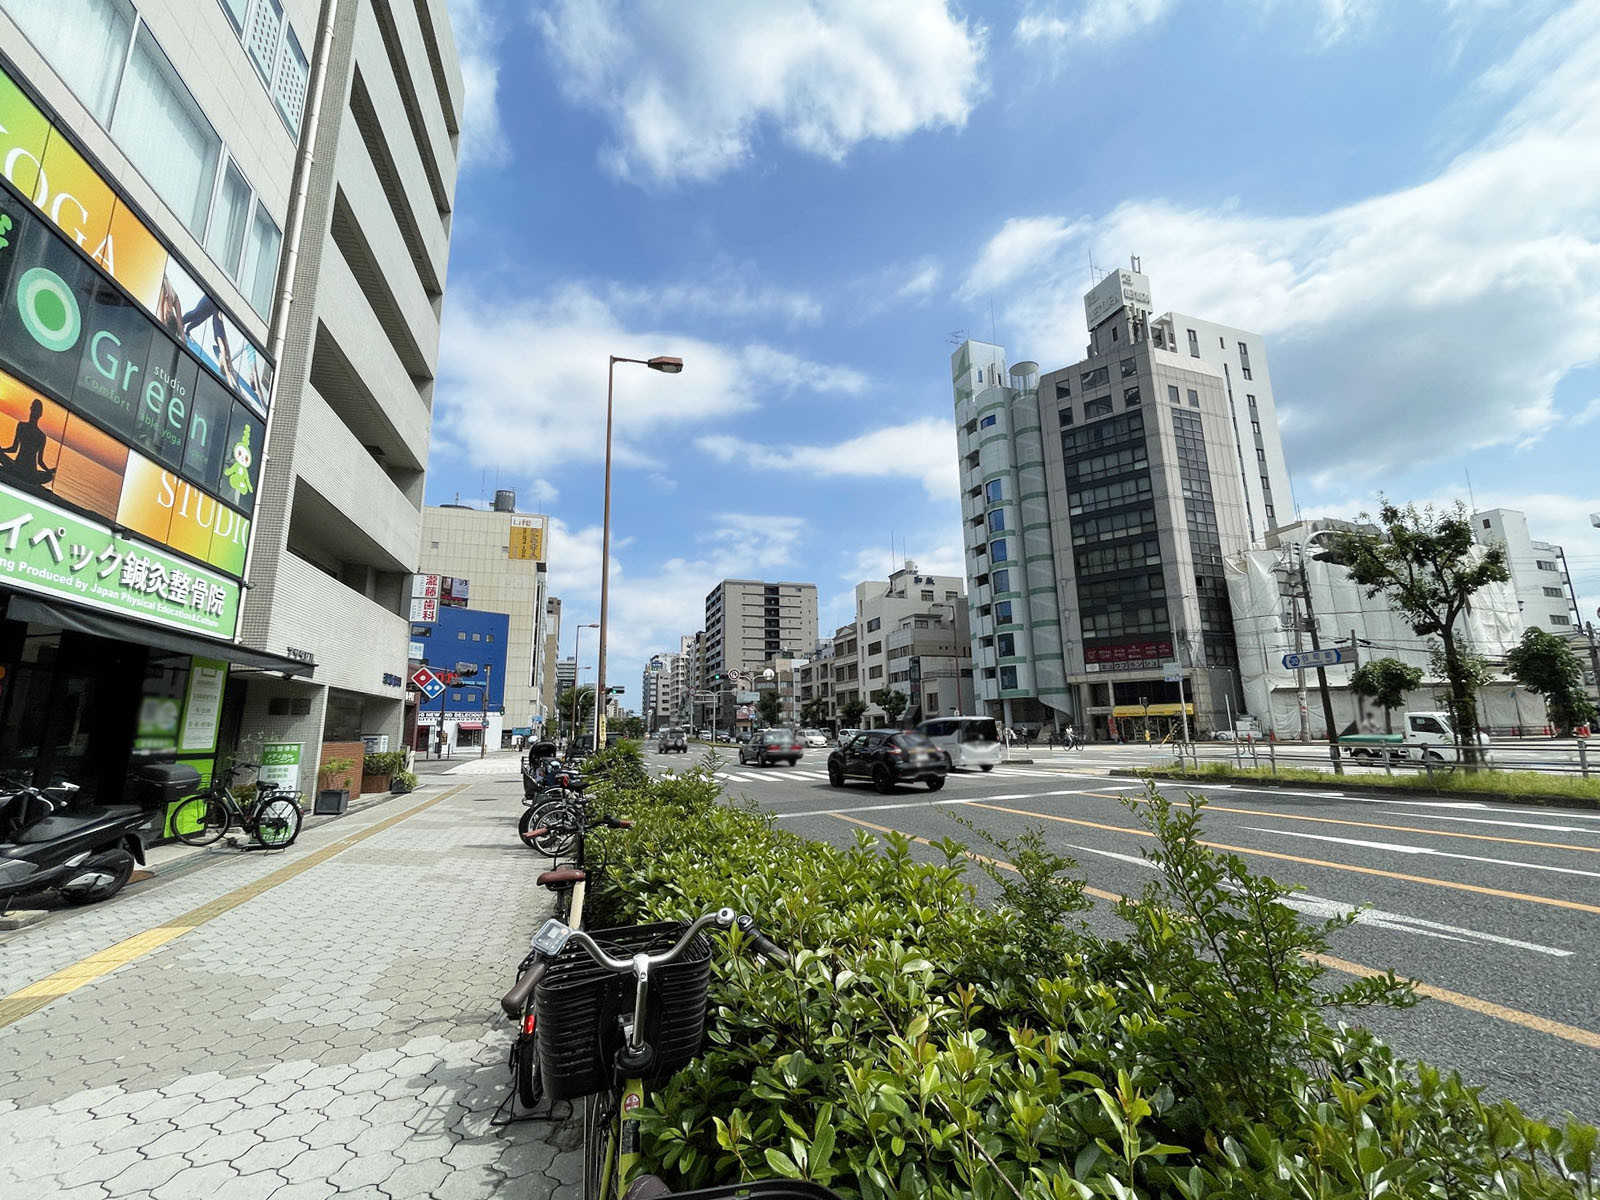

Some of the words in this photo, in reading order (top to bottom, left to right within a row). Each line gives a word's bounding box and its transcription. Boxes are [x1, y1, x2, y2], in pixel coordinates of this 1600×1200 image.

[0, 124, 115, 277] OGA
[84, 375, 131, 411] comfort
[90, 330, 208, 447] Green
[154, 365, 186, 396] studio
[159, 426, 182, 446] yoga
[0, 512, 227, 616] イペック鍼灸整骨院
[18, 561, 73, 586] Produced
[75, 578, 89, 593] by
[90, 583, 119, 601] Japan
[121, 592, 156, 611] Physical
